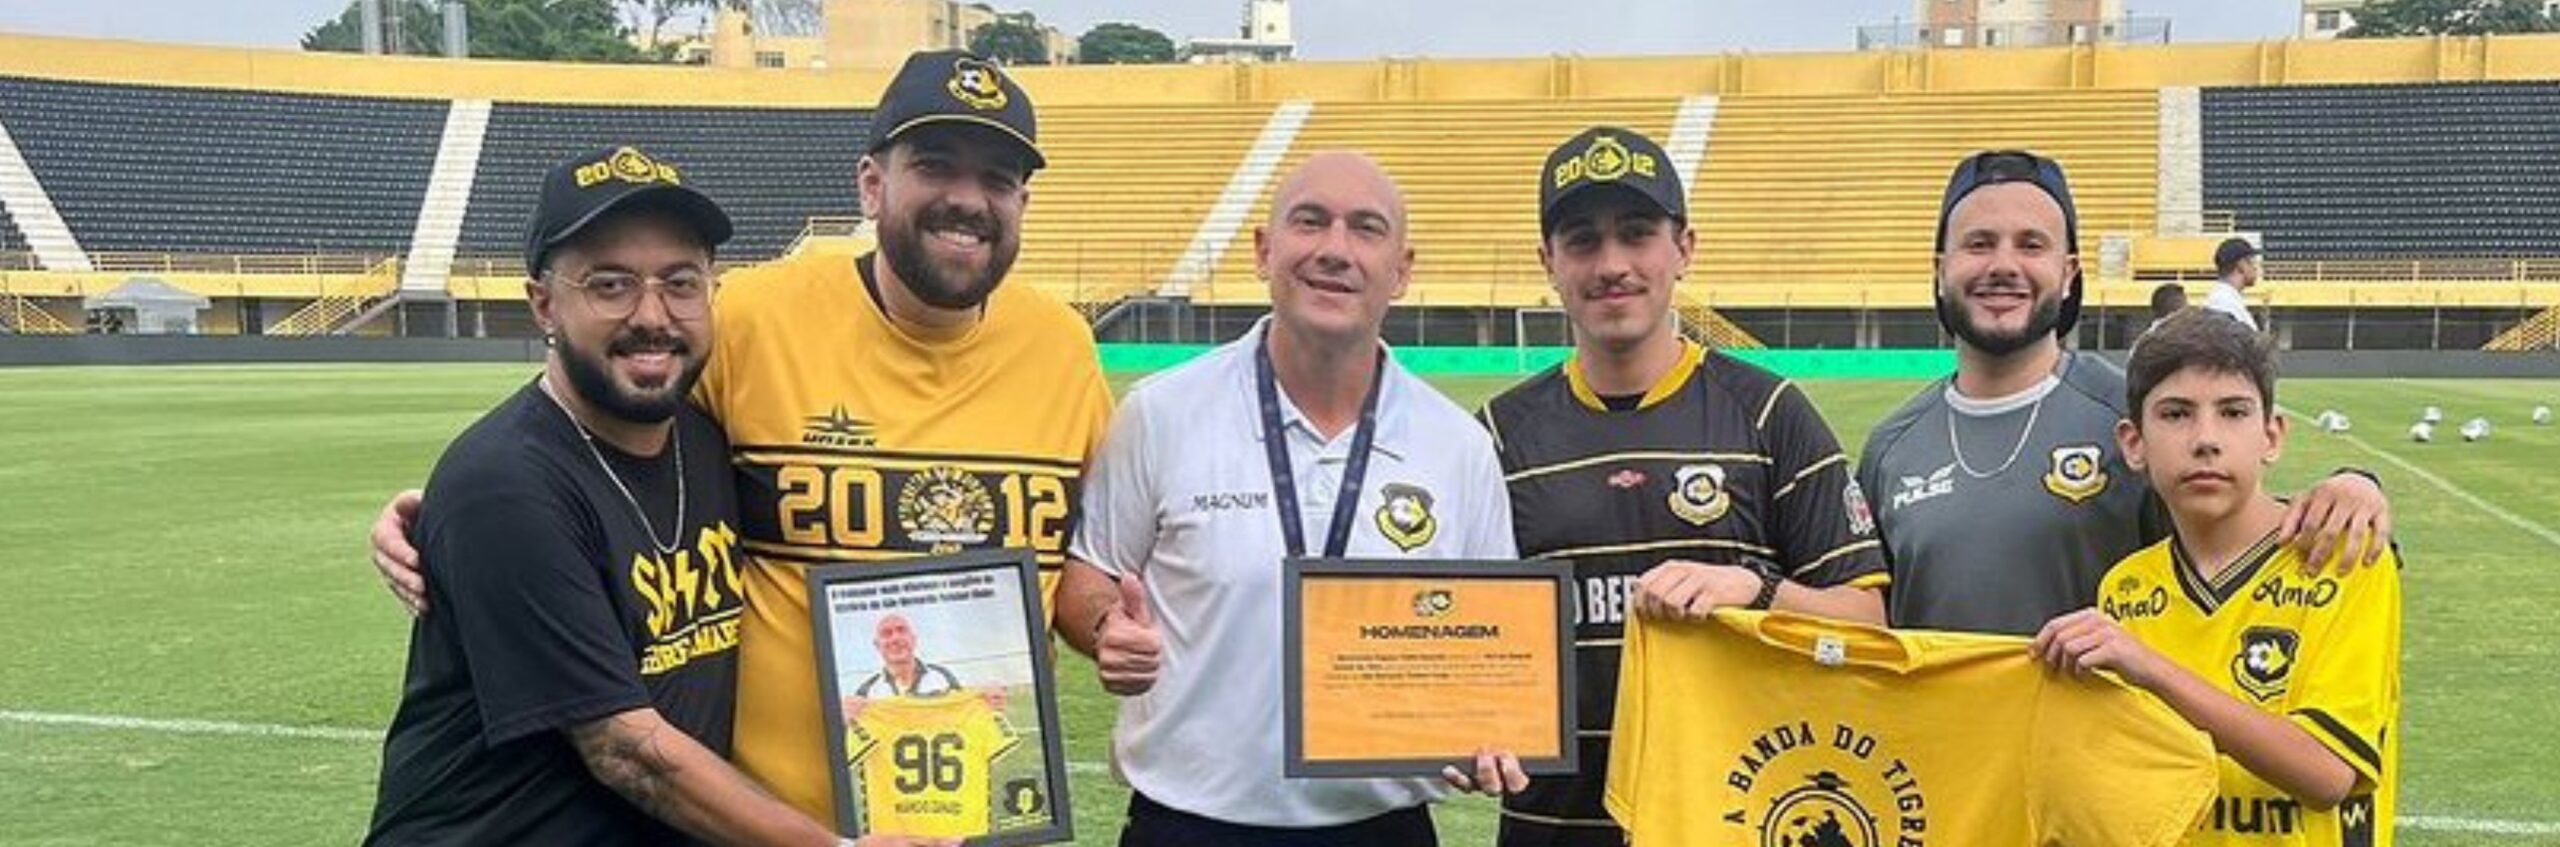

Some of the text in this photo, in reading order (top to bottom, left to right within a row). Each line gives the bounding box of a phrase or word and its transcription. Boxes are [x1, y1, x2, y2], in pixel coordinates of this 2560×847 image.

[776, 464, 885, 548] 20
[1000, 472, 1068, 551] 12
[1358, 624, 1499, 640] HOMENAGEM
[892, 732, 966, 795] 96
[1723, 720, 1927, 847] A BANDA DO TIGRE
